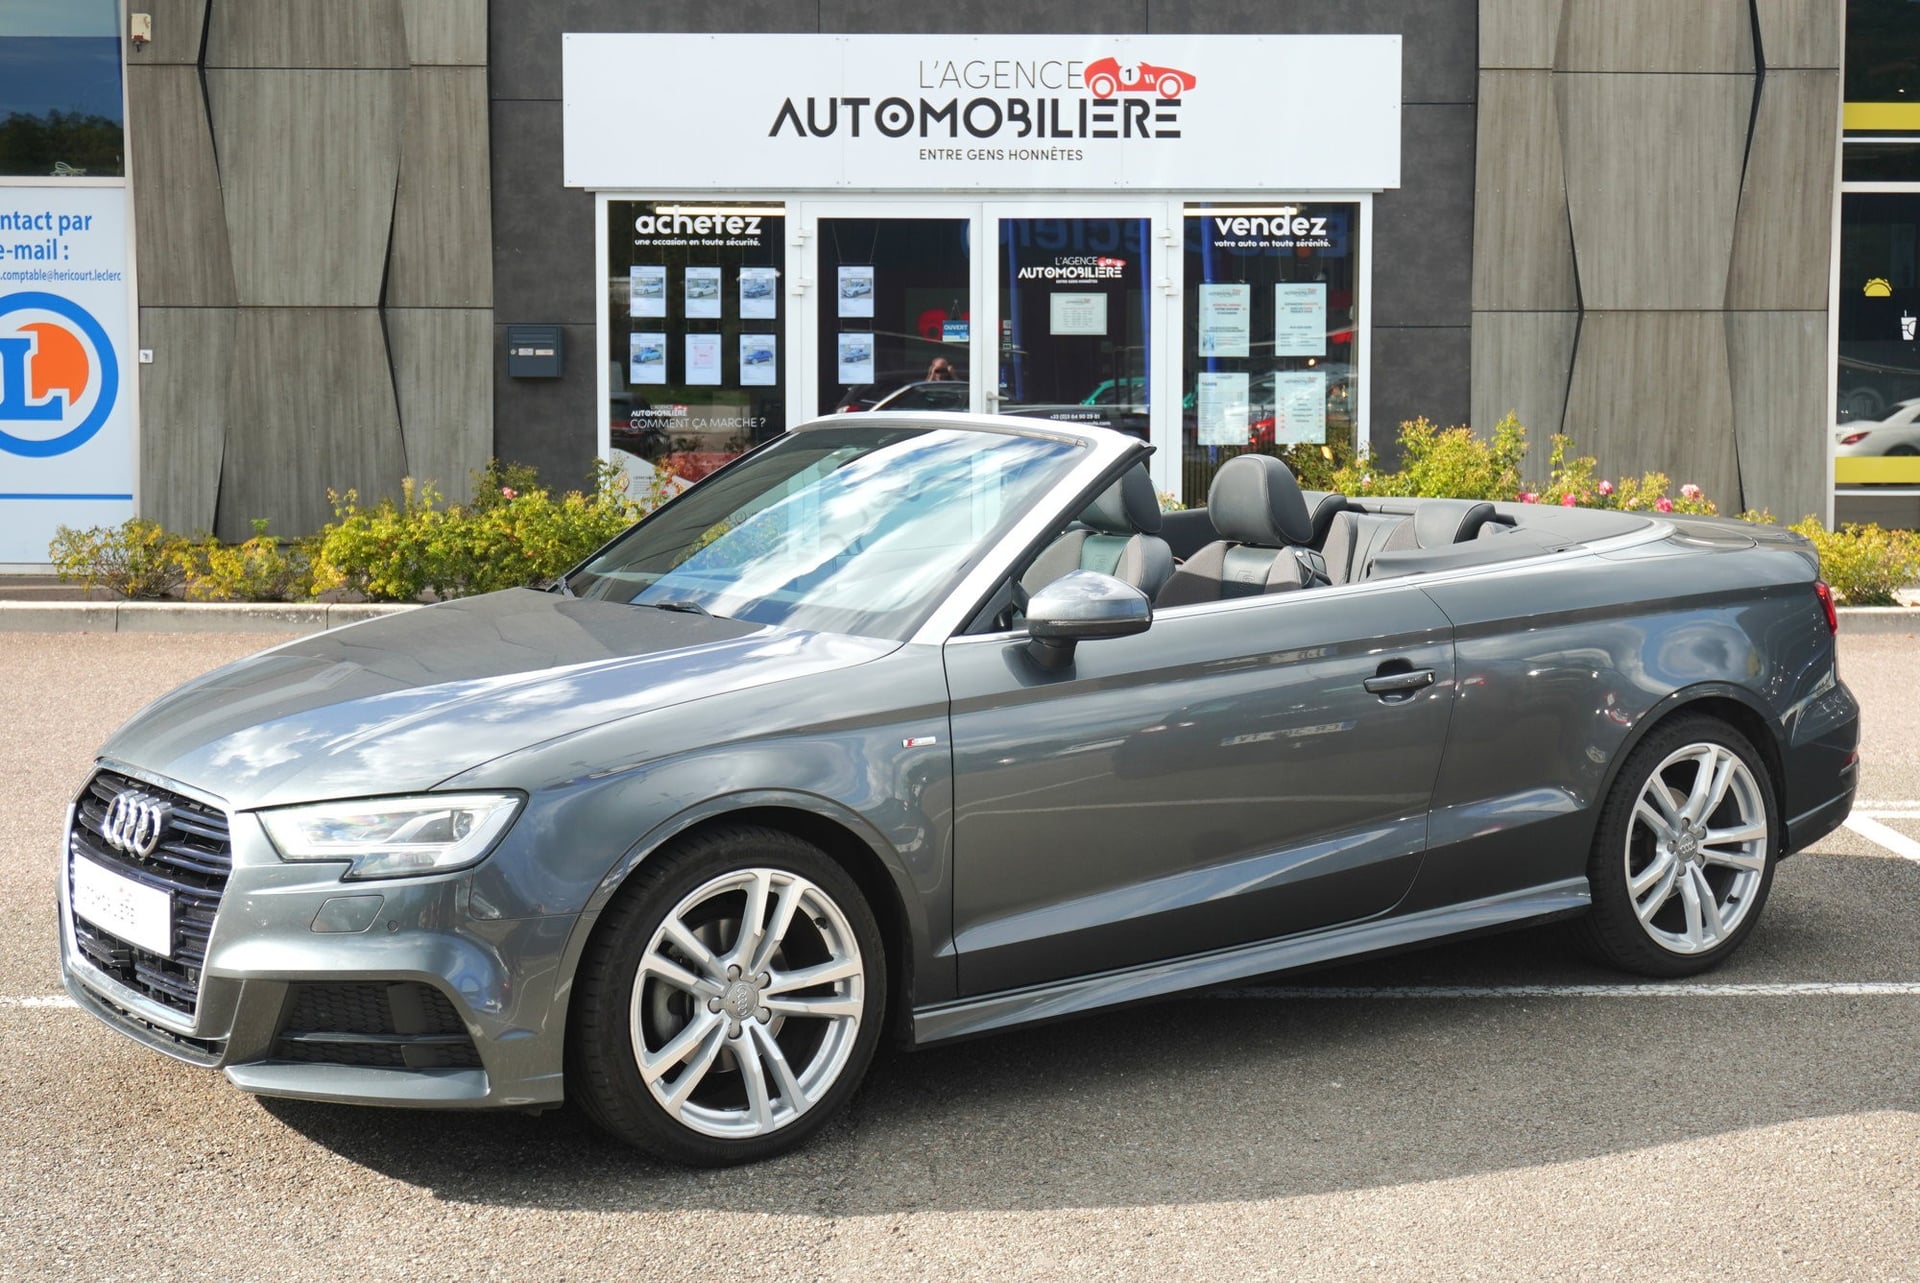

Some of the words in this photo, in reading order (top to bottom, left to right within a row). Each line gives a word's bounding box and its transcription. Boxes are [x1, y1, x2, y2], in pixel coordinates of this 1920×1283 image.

[920, 61, 1083, 89] L'AGENCE
[920, 149, 962, 161] ENTRE
[967, 149, 1004, 161] GENS
[1009, 146, 1083, 161] HONNÊTES
[58, 214, 92, 236] par
[635, 205, 762, 235] achetez
[1215, 206, 1327, 236] vendez
[652, 237, 687, 246] occasion
[702, 238, 724, 246] toute
[1055, 257, 1098, 265] L'AGENCE
[630, 418, 689, 429] COMMENT
[691, 418, 707, 430] ÇA
[709, 418, 757, 428] MARCHE
